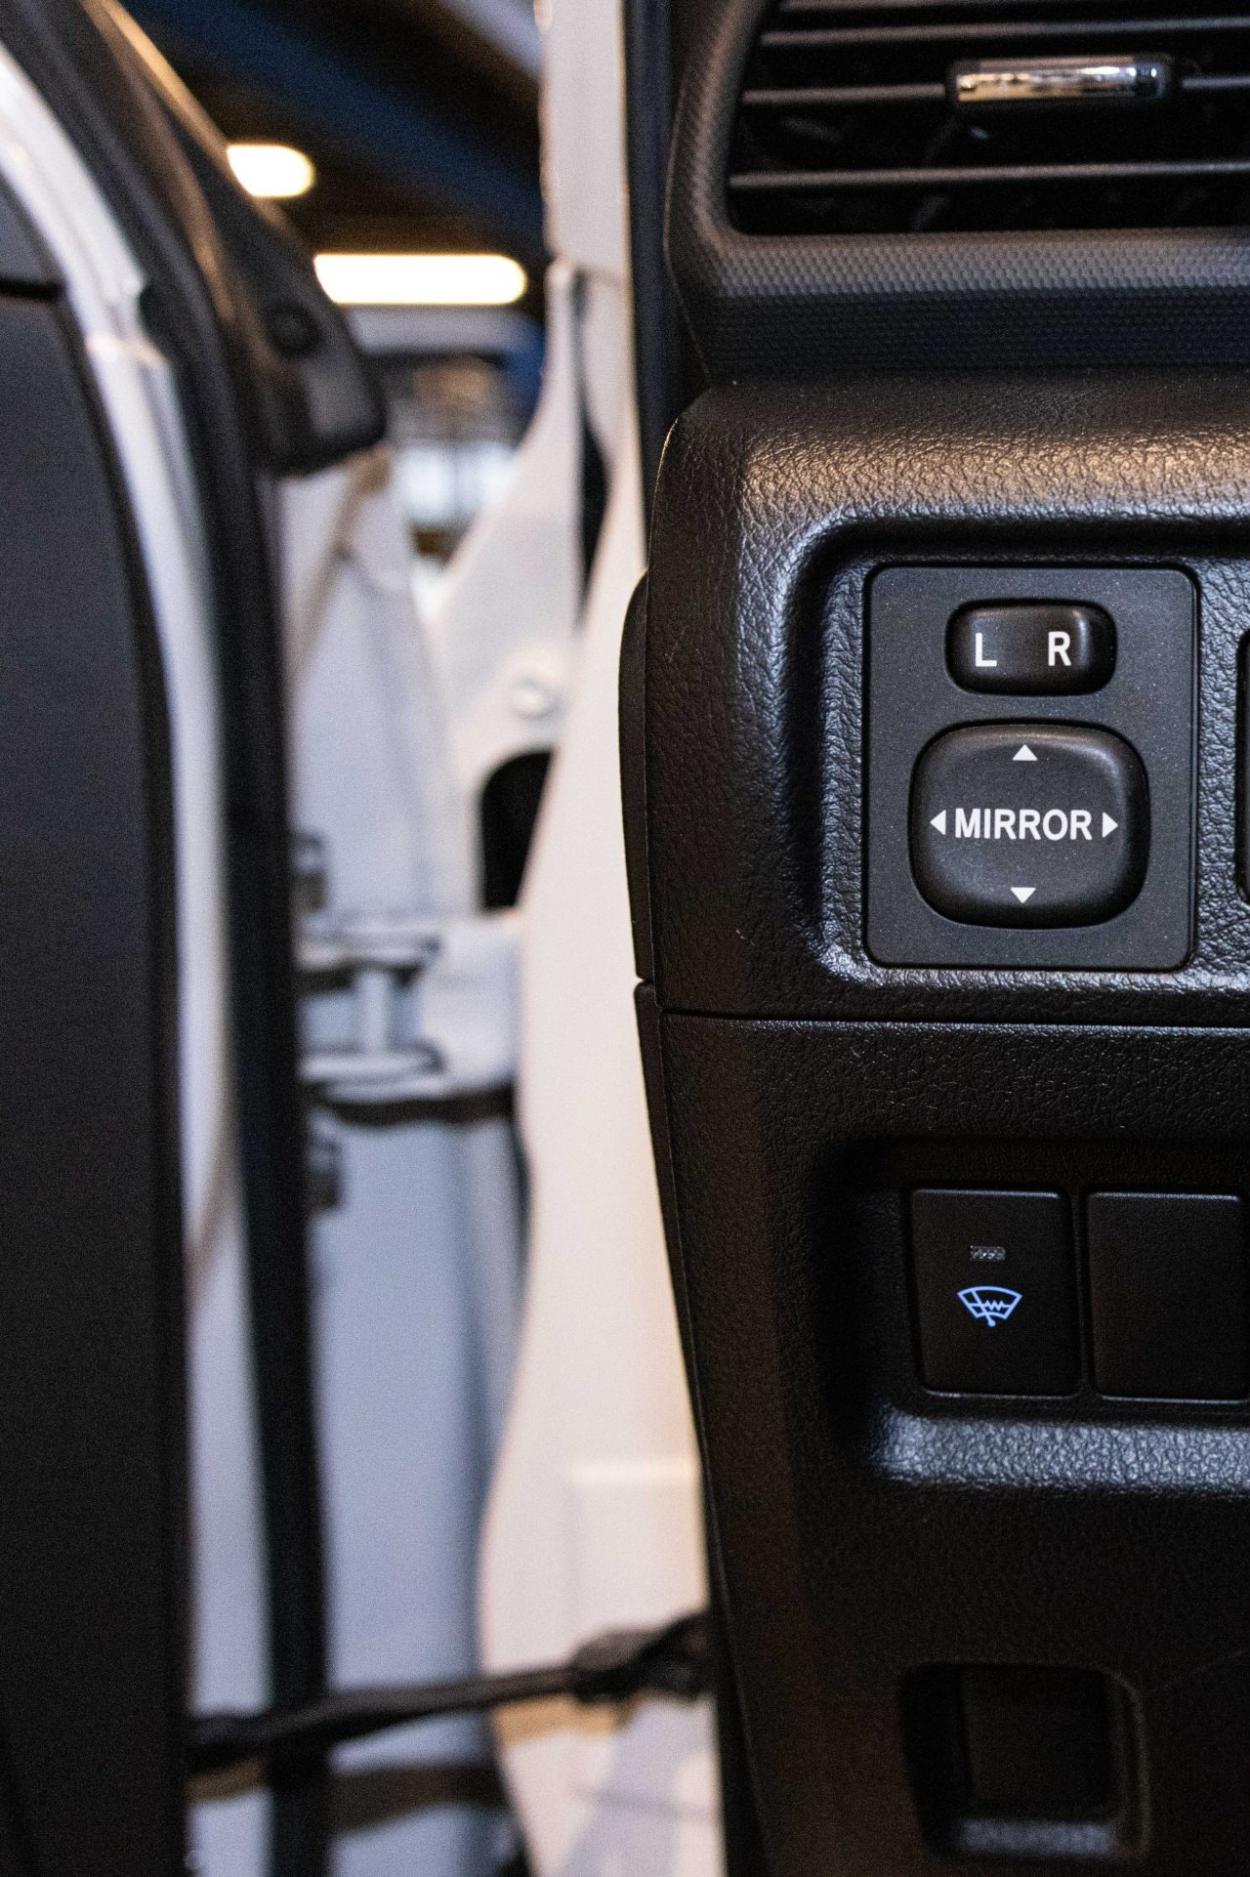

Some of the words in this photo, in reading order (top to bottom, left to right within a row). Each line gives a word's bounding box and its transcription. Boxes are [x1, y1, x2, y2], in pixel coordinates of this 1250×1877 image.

[974, 632, 998, 668] L
[1046, 630, 1073, 667] R
[954, 807, 1094, 842] MIRROR
